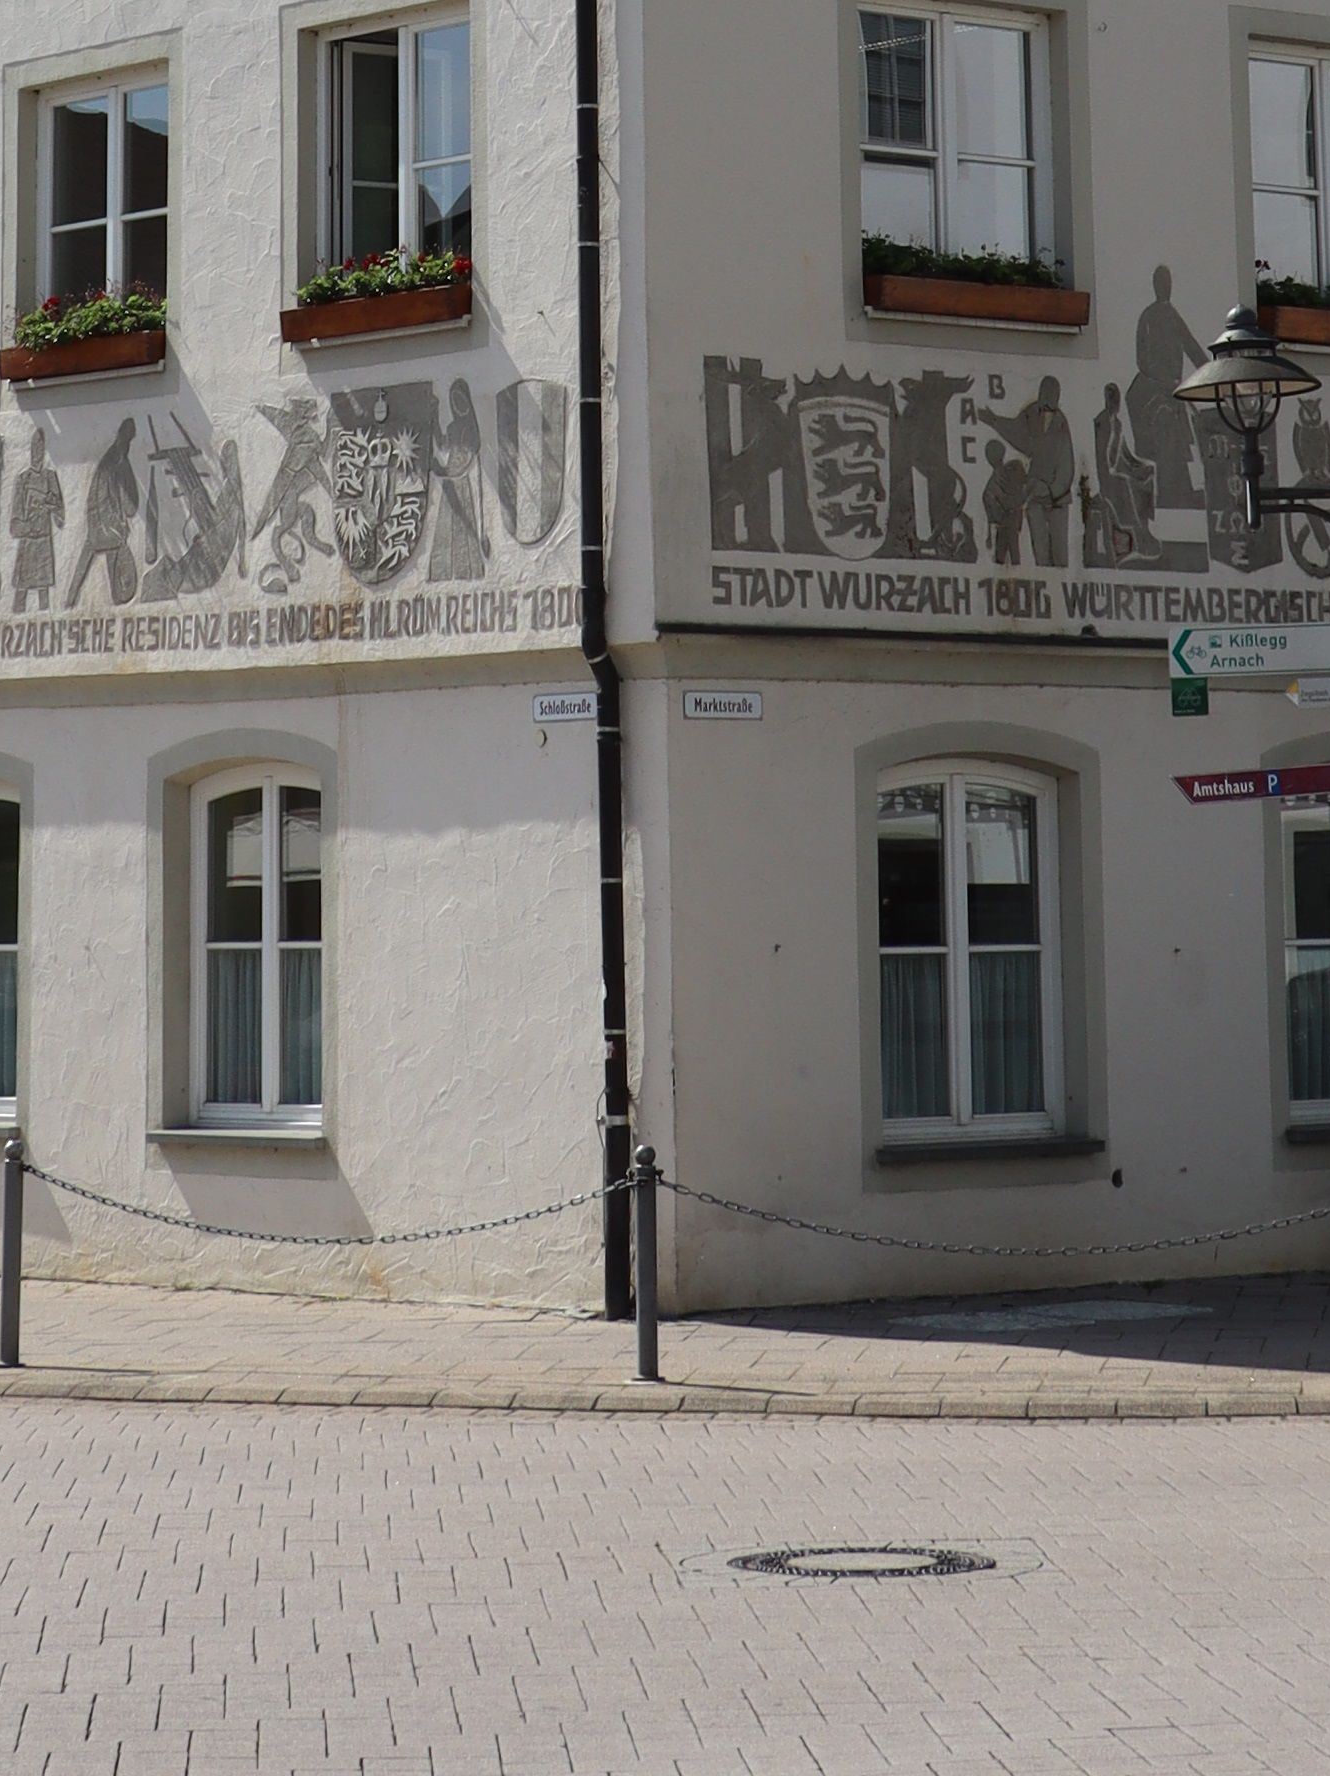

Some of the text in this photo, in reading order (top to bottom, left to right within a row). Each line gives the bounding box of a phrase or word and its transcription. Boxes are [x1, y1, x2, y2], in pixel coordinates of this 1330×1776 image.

[988, 374, 1005, 399] B
[960, 398, 977, 425] A
[961, 436, 977, 463] C
[712, 567, 814, 610] STADT
[817, 569, 971, 616] WURZACH
[977, 577, 1052, 620] 1806
[121, 612, 222, 653] RESIDENZ
[227, 609, 261, 649] BIS
[265, 603, 322, 647] ENDE
[323, 599, 365, 641] DES
[1229, 633, 1287, 649] Kißlegg
[1210, 653, 1265, 668] Arnach
[539, 699, 592, 716] Schloßstraße
[693, 697, 753, 714] Marktstraße
[1192, 774, 1278, 798] Amtshaus P
